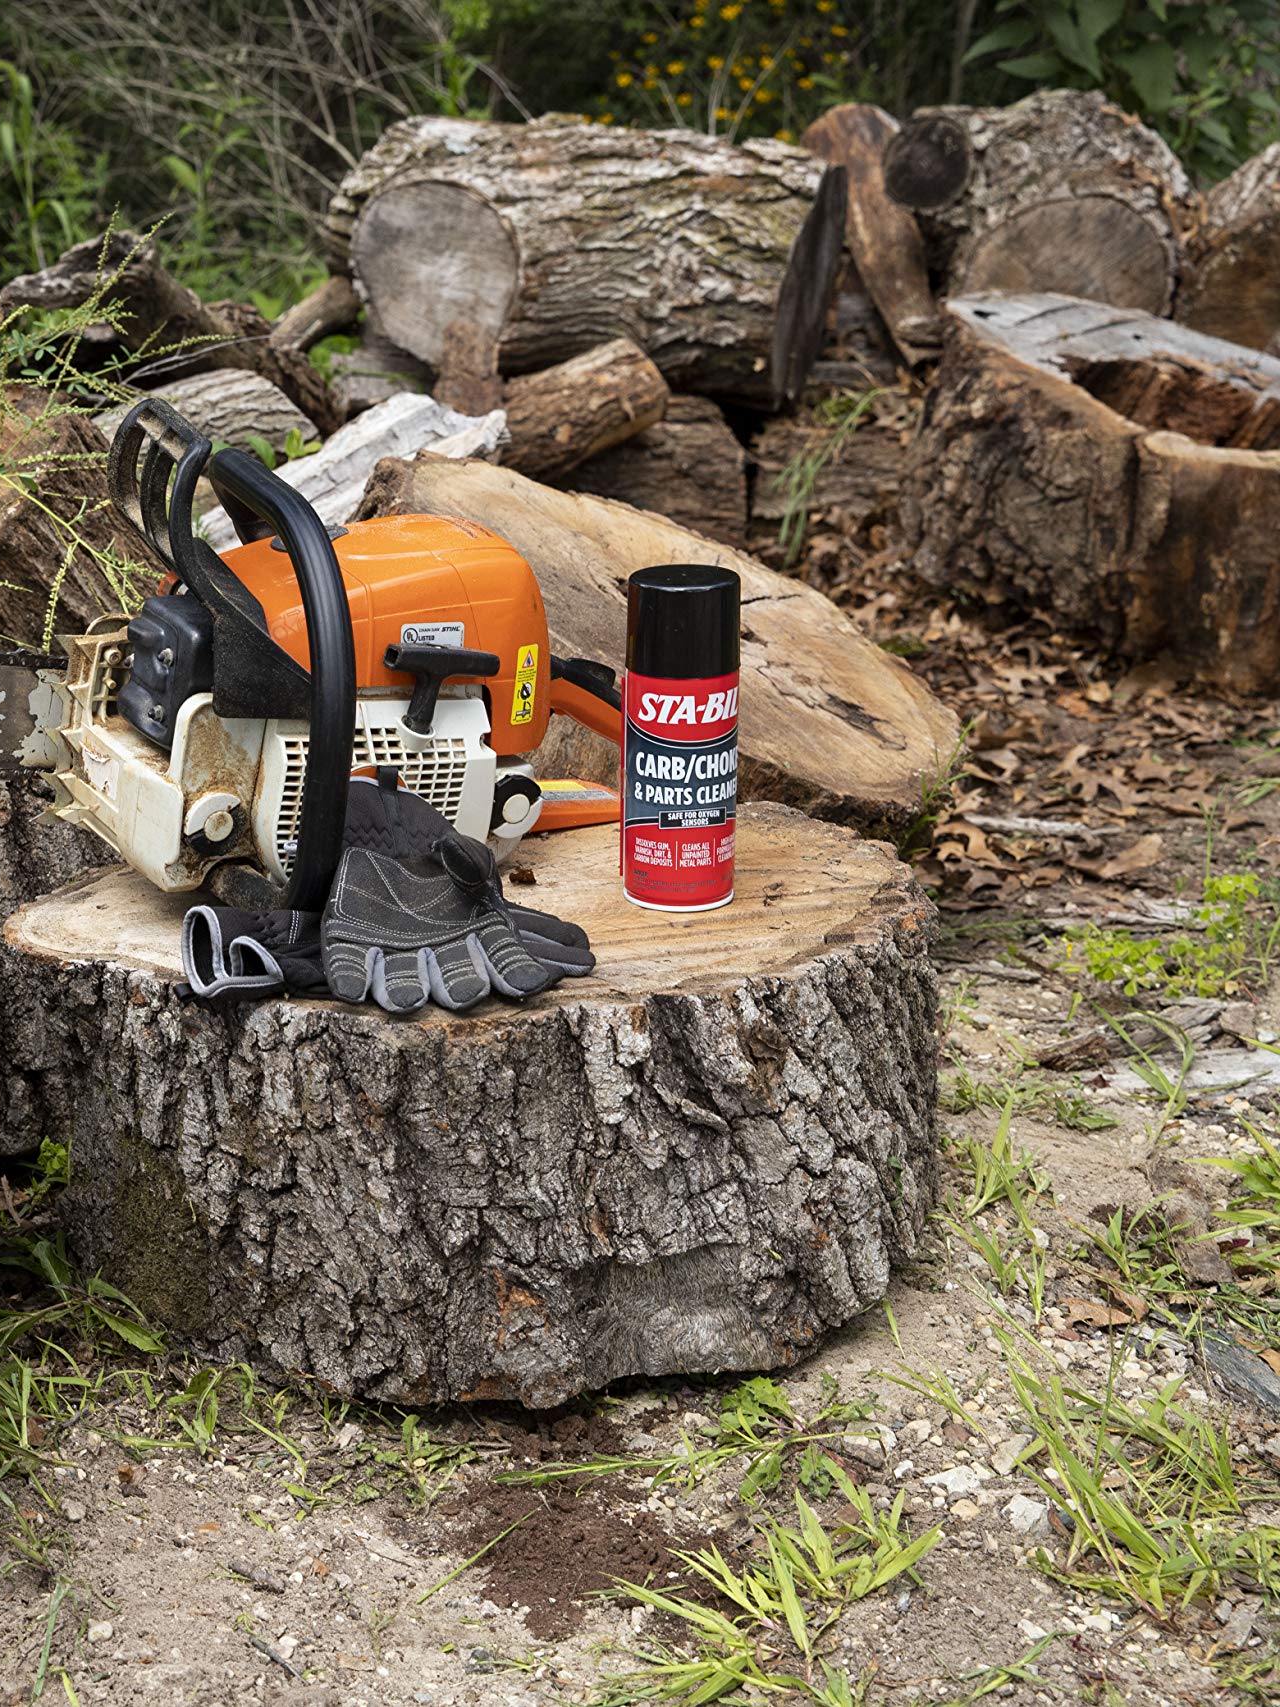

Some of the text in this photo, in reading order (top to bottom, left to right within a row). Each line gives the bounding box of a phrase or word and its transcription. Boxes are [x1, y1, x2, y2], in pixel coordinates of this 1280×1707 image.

[638, 686, 738, 724] STA-BIL
[634, 781, 643, 800] &
[645, 784, 693, 805] PARTS
[696, 776, 737, 805] CLEANE
[667, 809, 720, 821] SAFE FOR OXYGEN
[681, 818, 709, 827] SENSORS
[681, 843, 701, 852] CLEANS
[701, 841, 710, 850] ALL
[681, 850, 710, 860] UNPAINTED
[679, 857, 712, 867] METAL PARTS
